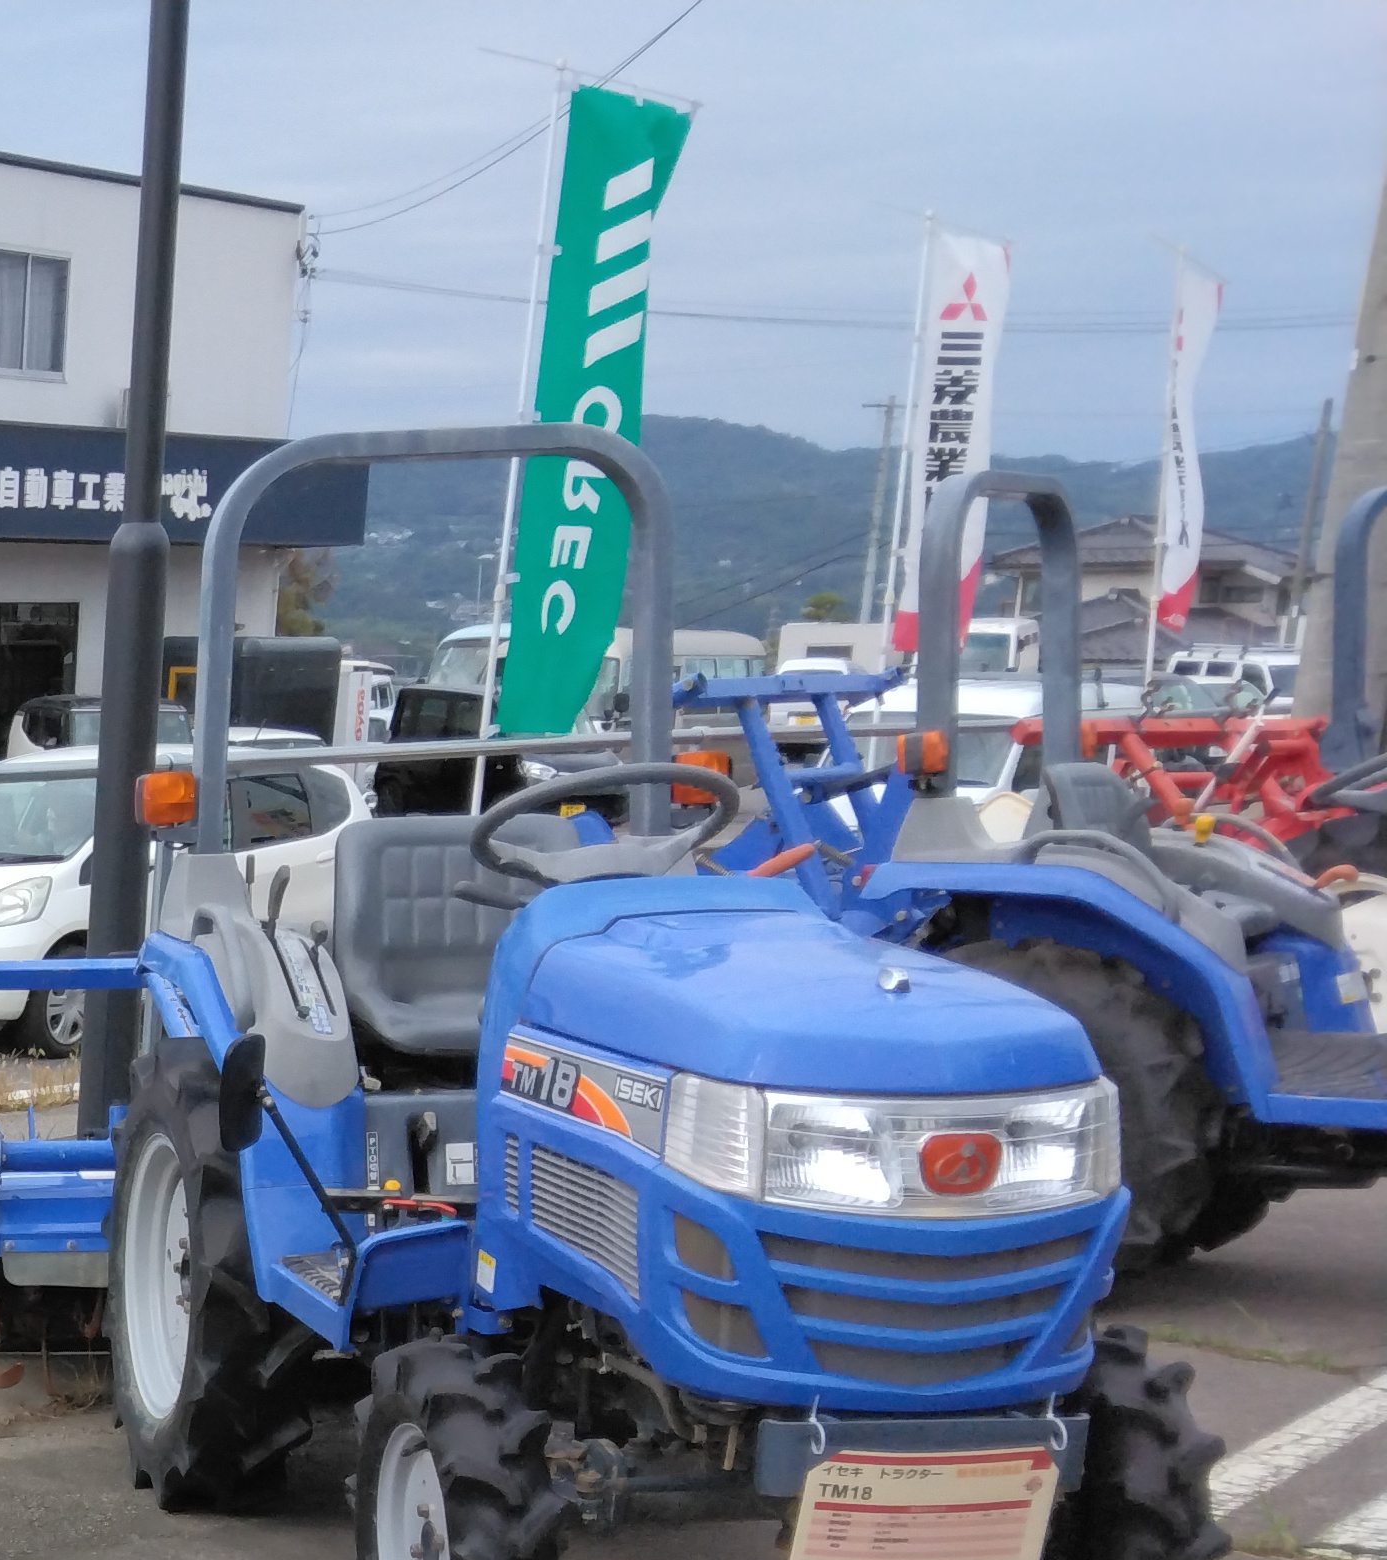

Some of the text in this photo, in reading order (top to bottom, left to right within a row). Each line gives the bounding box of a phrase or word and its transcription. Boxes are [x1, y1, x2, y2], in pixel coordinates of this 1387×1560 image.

[924, 331, 984, 492] 三菱農業
[511, 1057, 663, 1110] TM18 ISEKI
[821, 1464, 864, 1478] イセキ
[879, 1466, 944, 1480] トラクター
[818, 1482, 873, 1501] TM18
